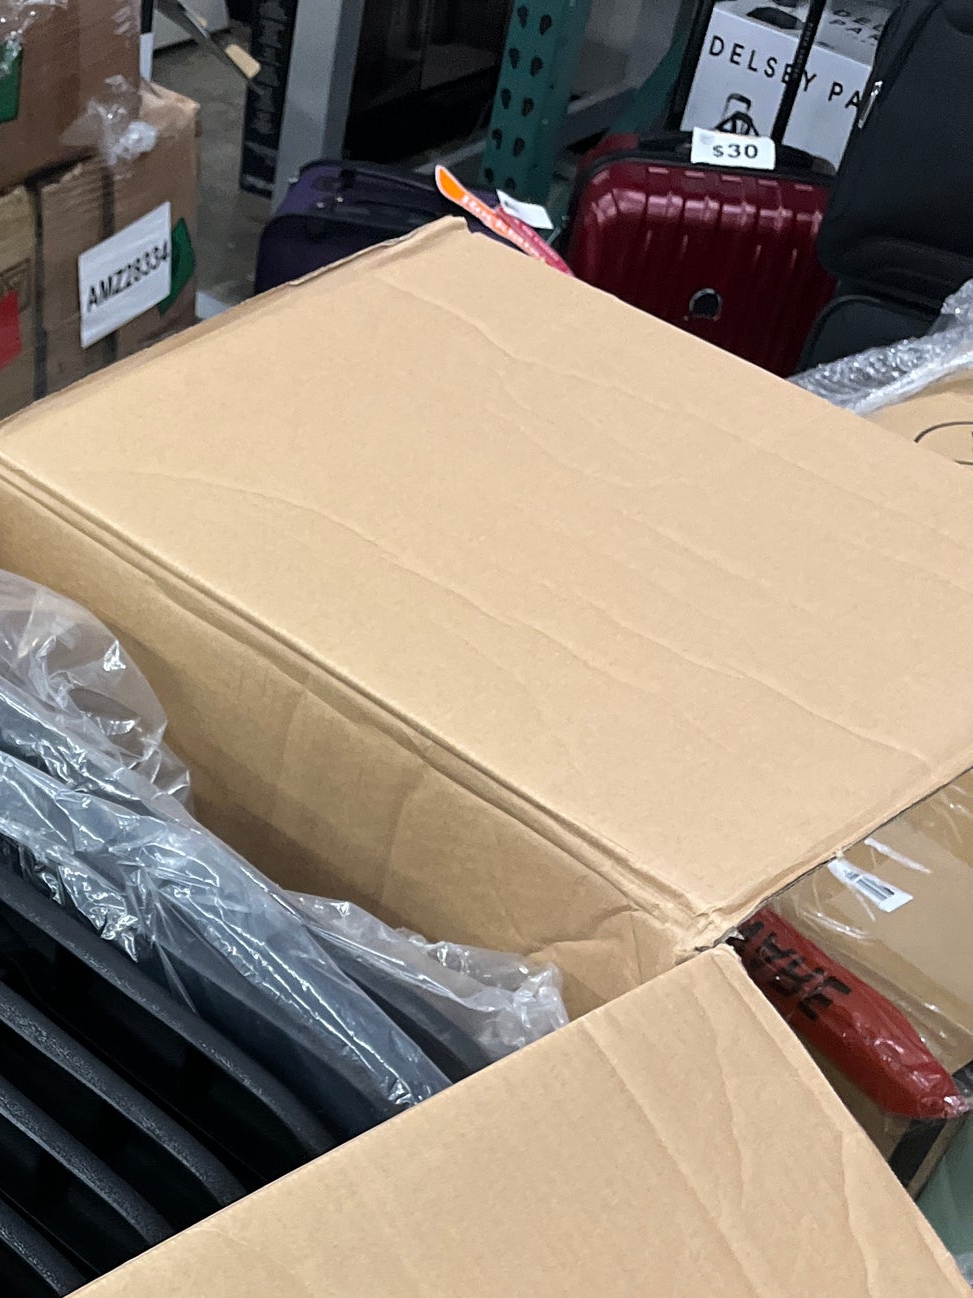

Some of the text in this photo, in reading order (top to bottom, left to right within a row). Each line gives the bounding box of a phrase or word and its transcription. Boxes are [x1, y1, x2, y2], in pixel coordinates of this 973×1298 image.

[708, 34, 818, 92] DELSEY
[712, 143, 759, 159] $30
[87, 239, 170, 313] AMZ28334
